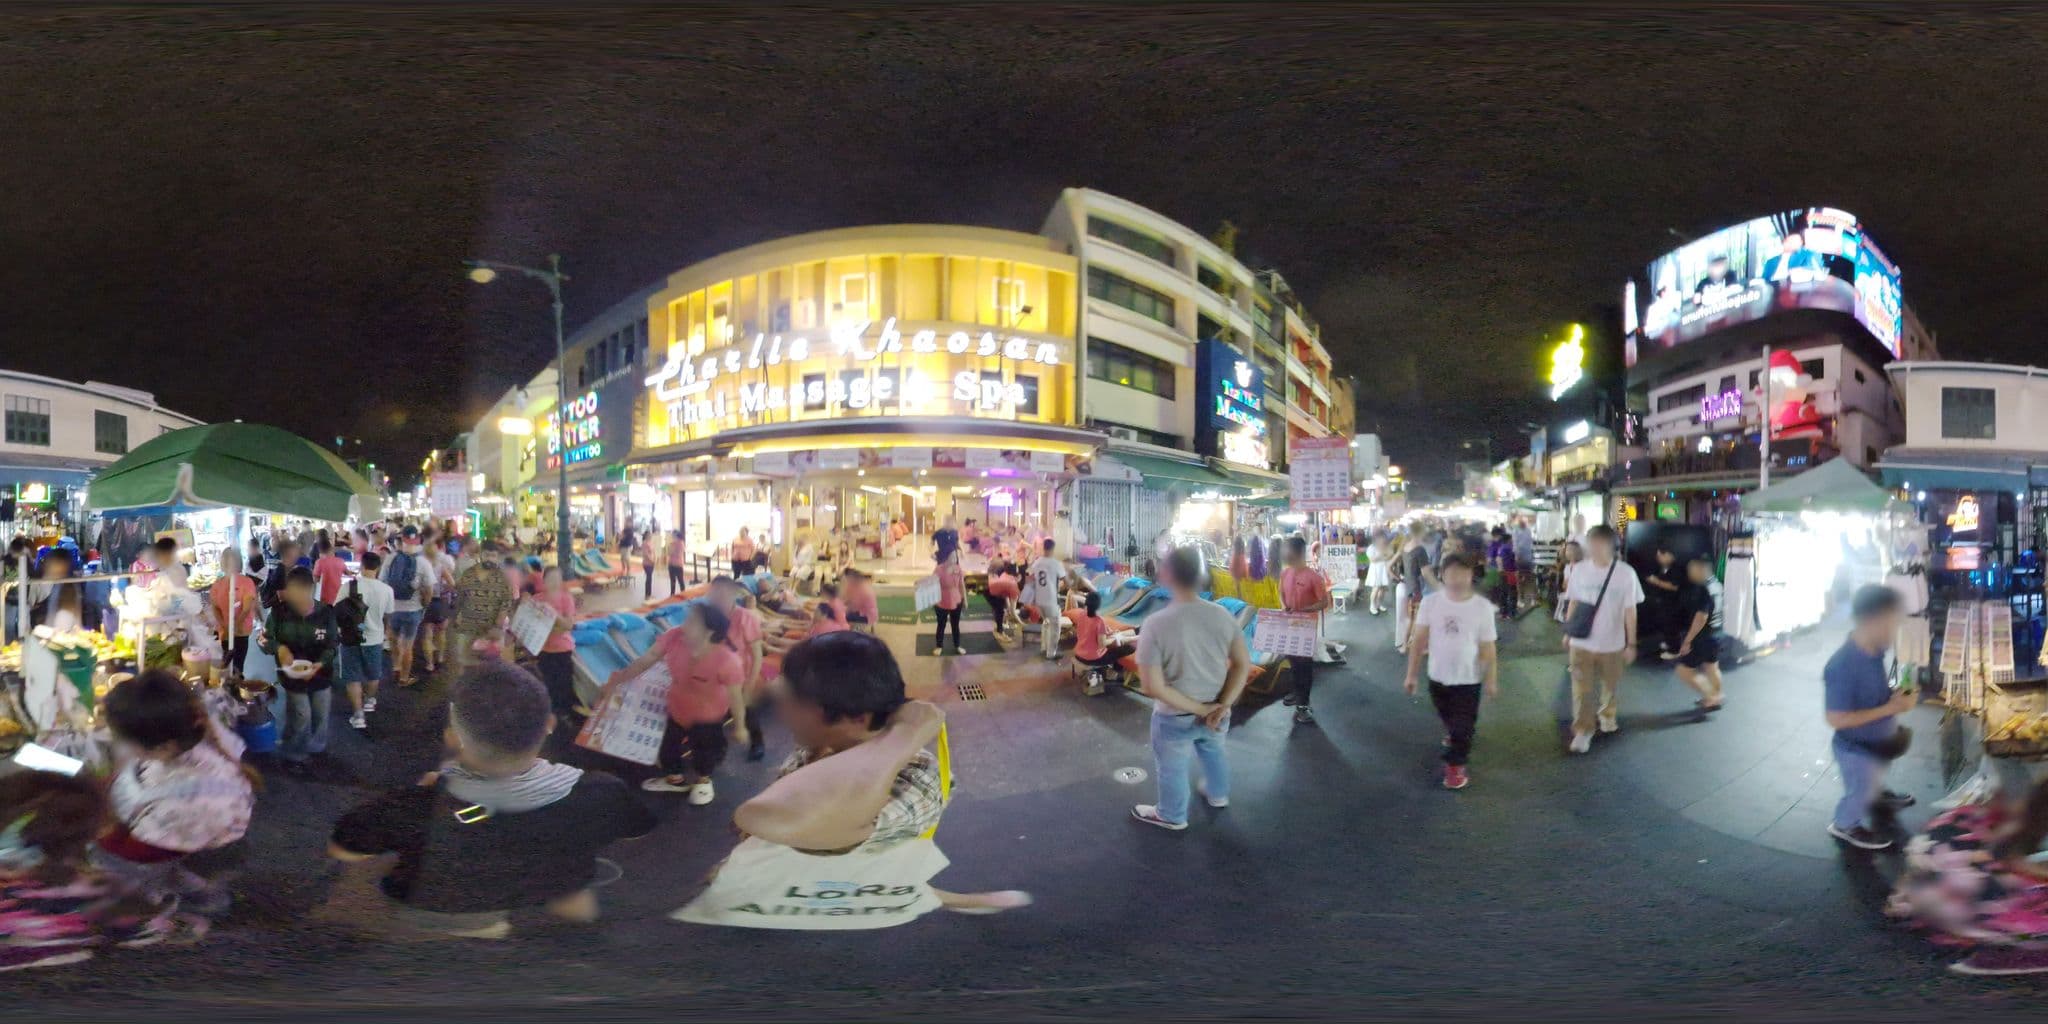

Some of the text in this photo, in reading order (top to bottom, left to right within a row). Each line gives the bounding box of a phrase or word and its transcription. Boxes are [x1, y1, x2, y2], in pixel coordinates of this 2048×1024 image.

[644, 316, 1060, 401] Charlie Khaosan
[668, 391, 727, 428] Thai
[738, 374, 894, 415] Massage
[953, 371, 1028, 409] Spa
[1038, 570, 1048, 587] 8
[784, 883, 916, 900] LoRa
